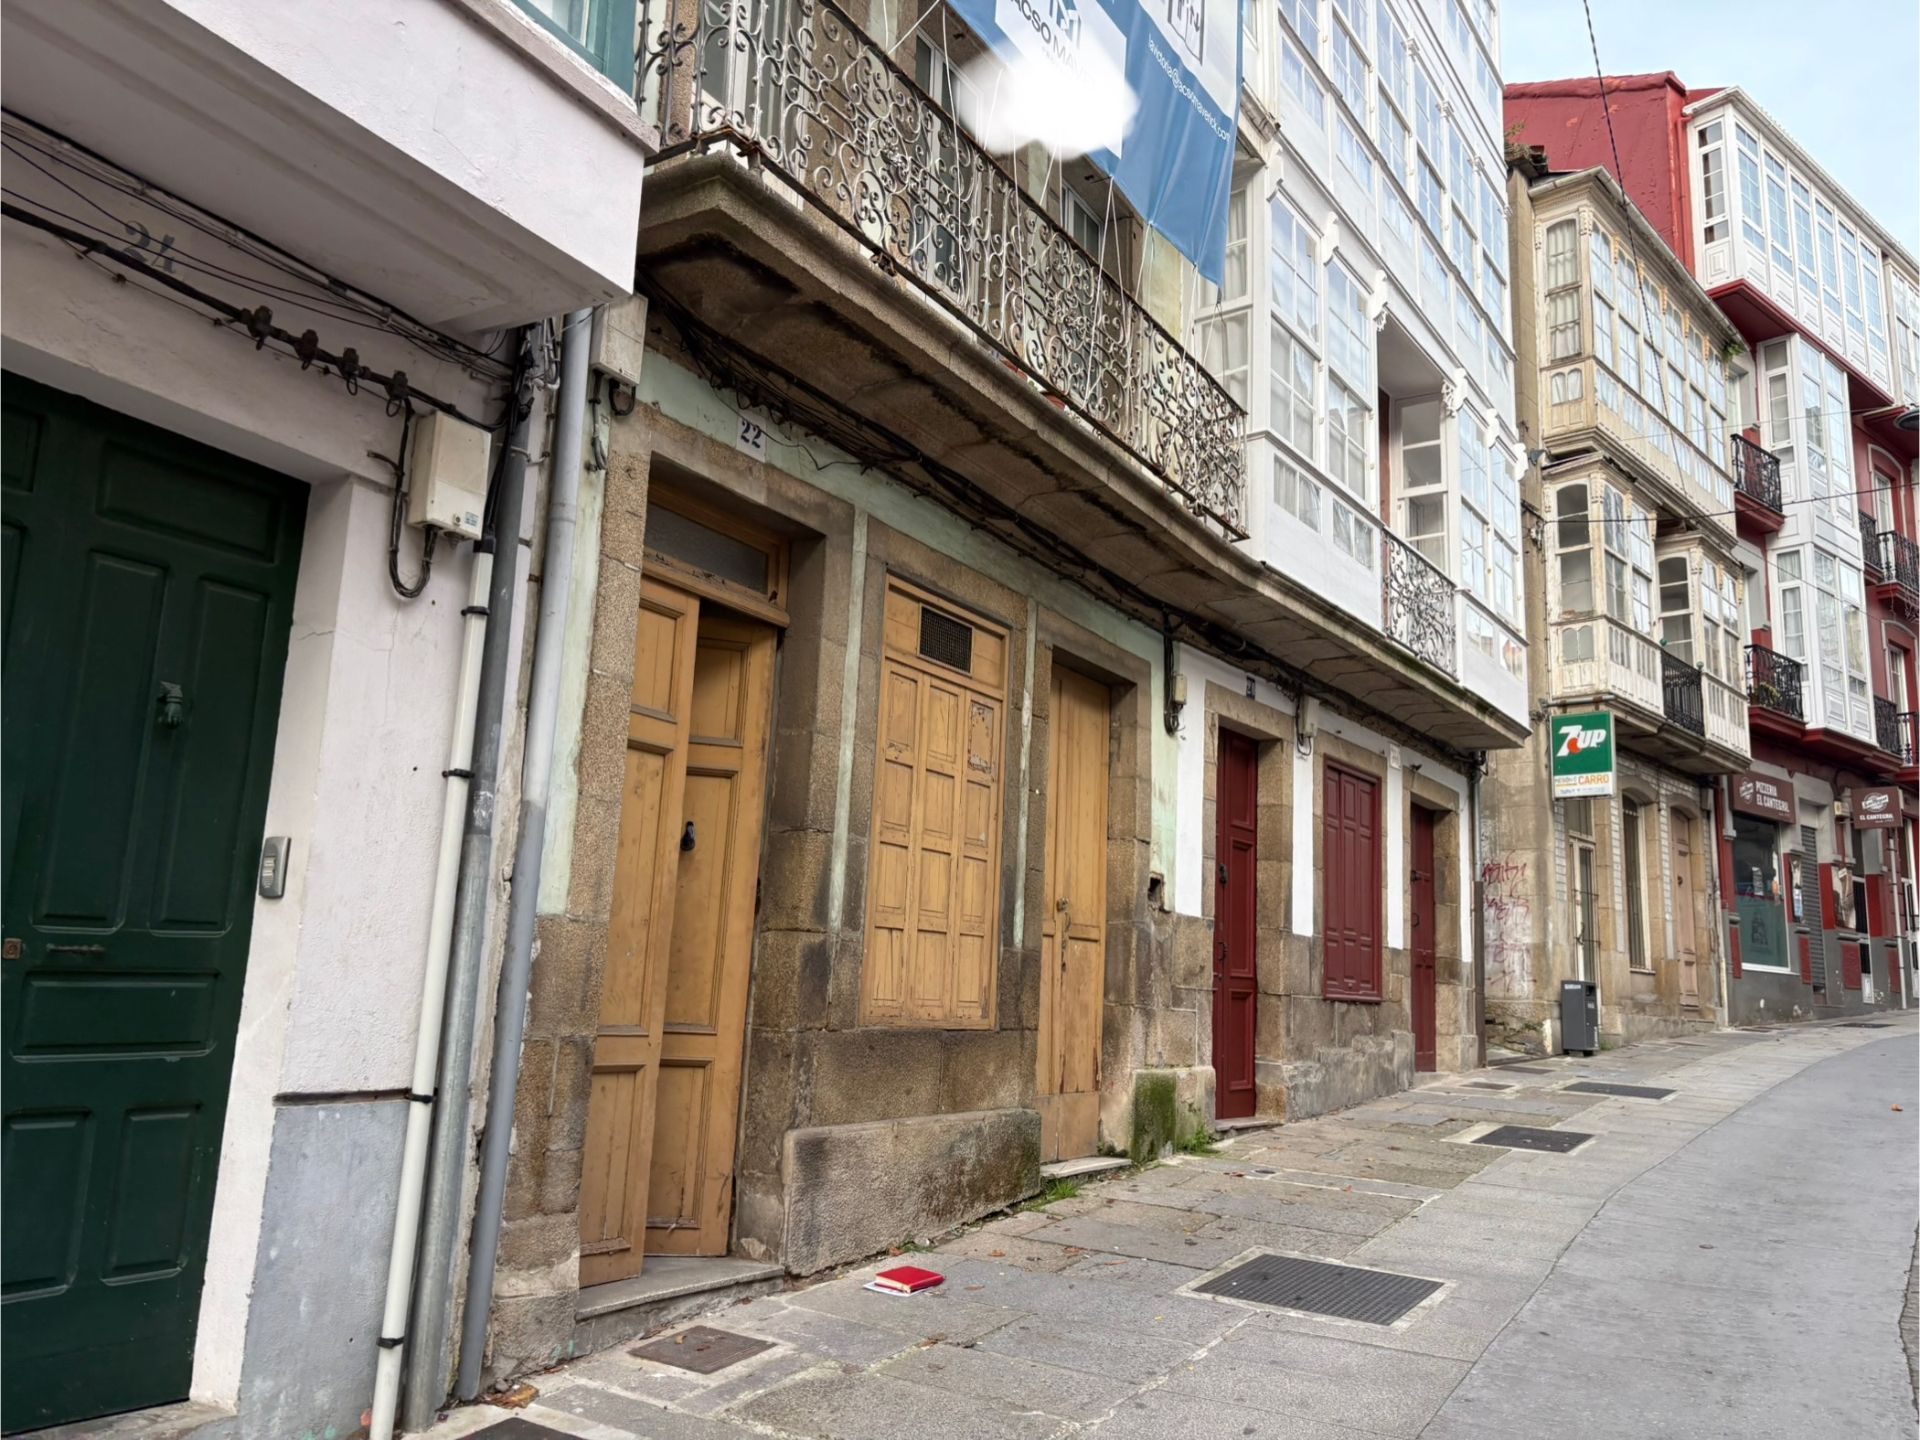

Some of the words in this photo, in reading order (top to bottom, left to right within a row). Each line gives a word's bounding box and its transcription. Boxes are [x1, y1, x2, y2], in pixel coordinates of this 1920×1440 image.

[741, 419, 761, 448] 22
[1556, 724, 1607, 757] 7UP
[1578, 774, 1610, 785] CARRO
[1756, 793, 1763, 806] EL
